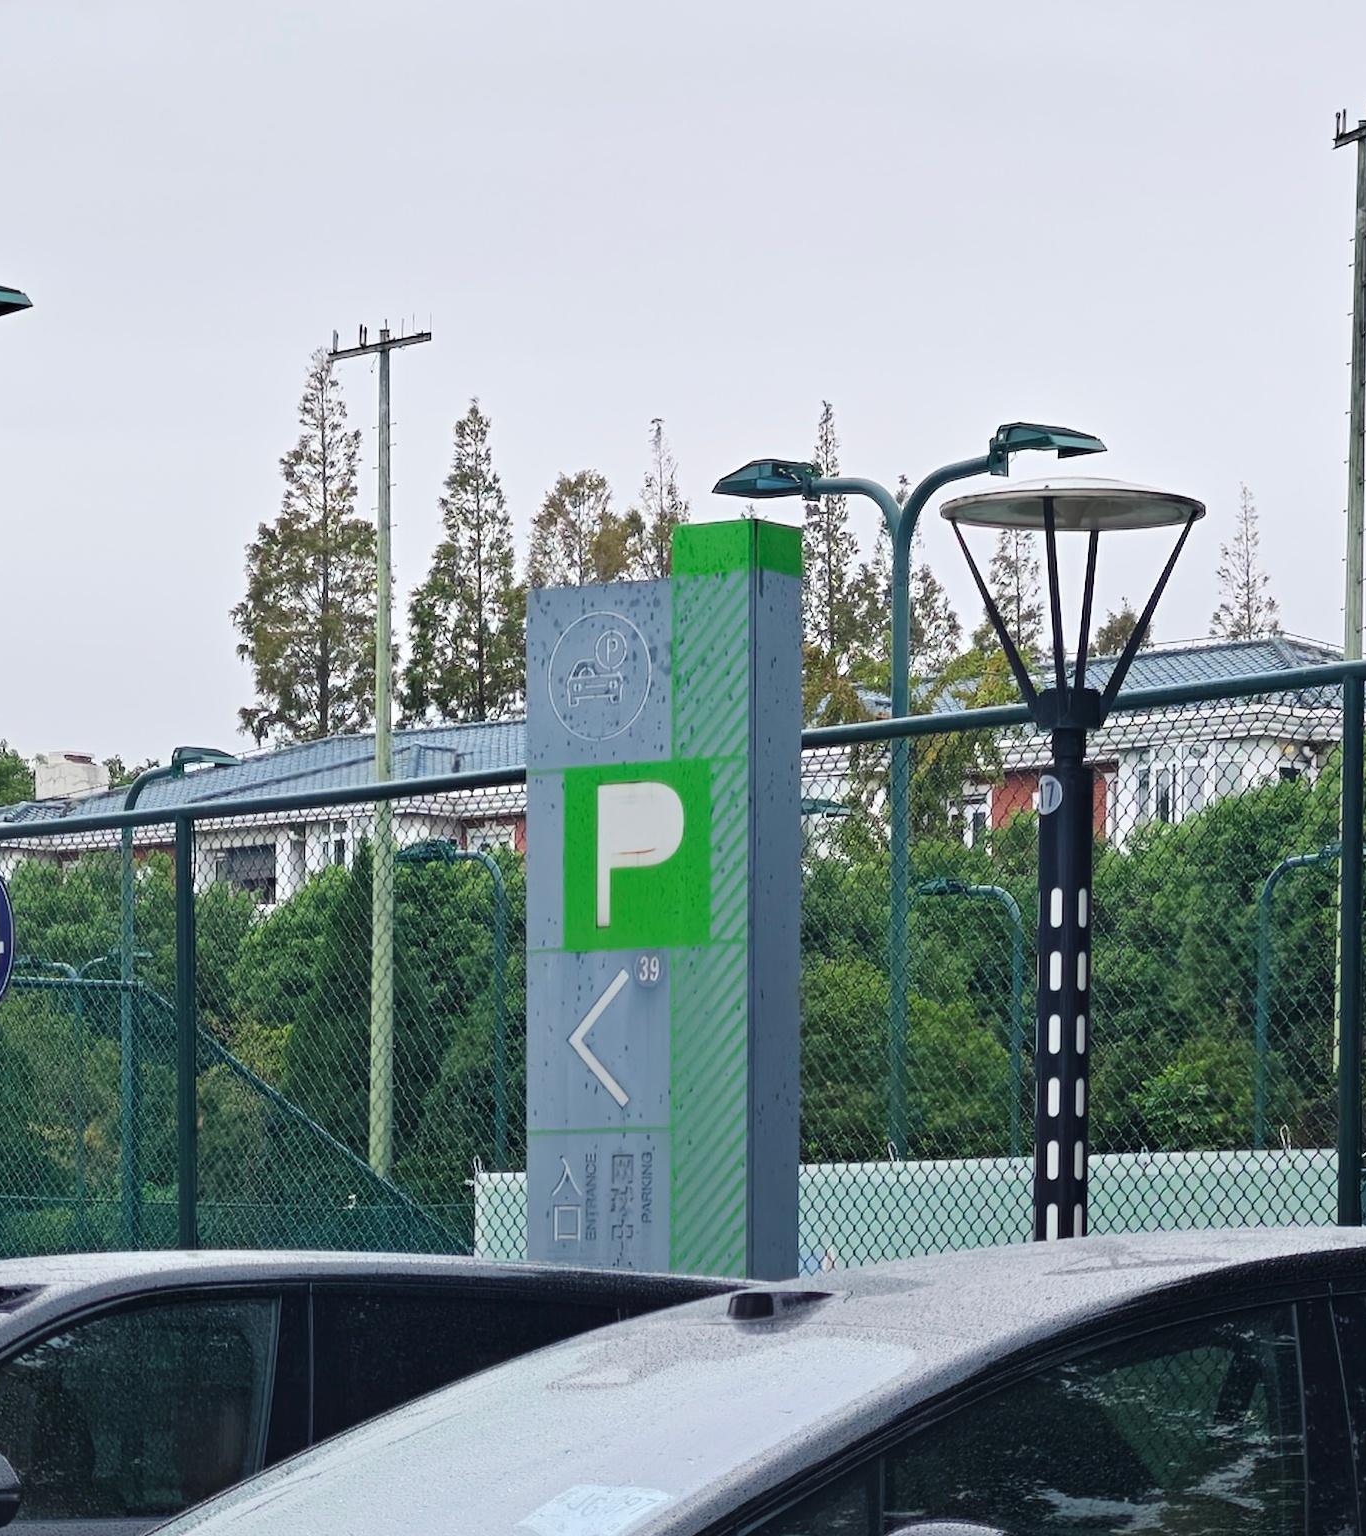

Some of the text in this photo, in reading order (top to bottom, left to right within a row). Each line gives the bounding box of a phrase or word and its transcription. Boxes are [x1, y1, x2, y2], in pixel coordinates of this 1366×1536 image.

[596, 780, 685, 929] P
[638, 957, 661, 982] 39
[552, 1155, 583, 1242] 入口
[585, 1153, 597, 1241] ENTRANCE
[641, 1152, 653, 1223] PARKING
